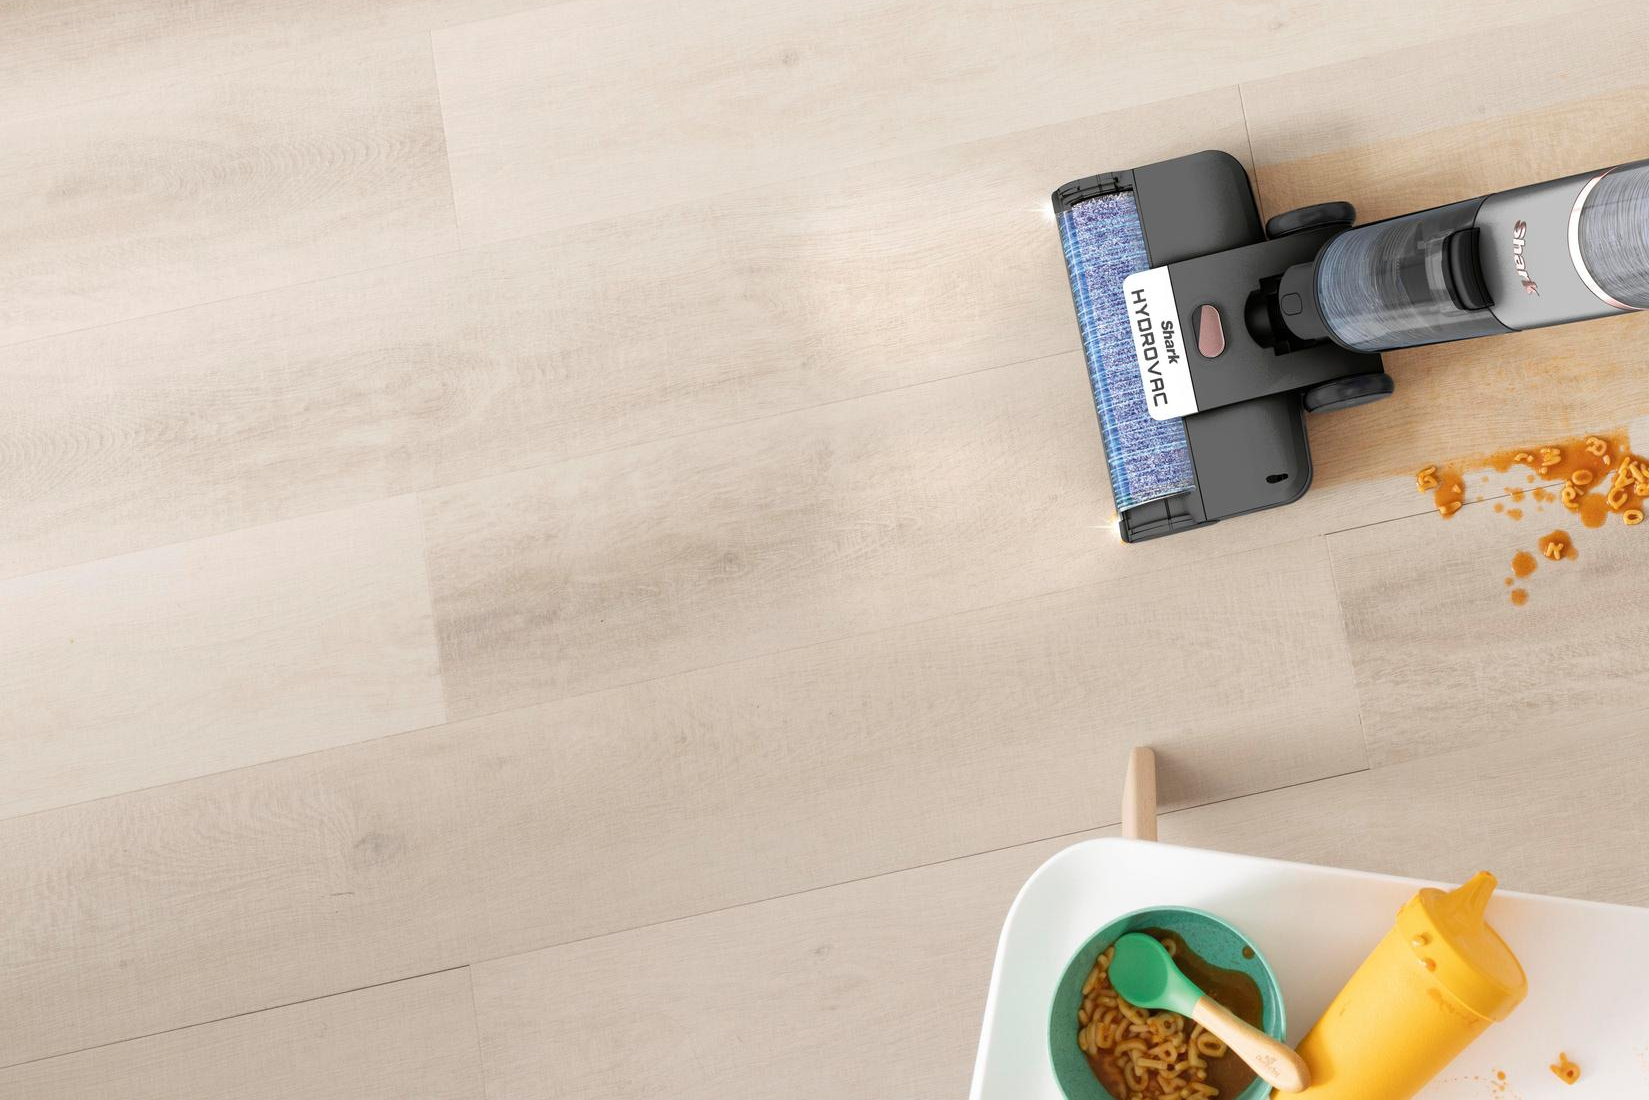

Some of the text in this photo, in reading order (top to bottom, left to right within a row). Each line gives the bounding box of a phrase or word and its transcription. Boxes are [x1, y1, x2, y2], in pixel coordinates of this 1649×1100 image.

[1513, 220, 1540, 296] Shark
[1131, 289, 1168, 407] HYDROVAC
[1161, 320, 1180, 364] Shark
